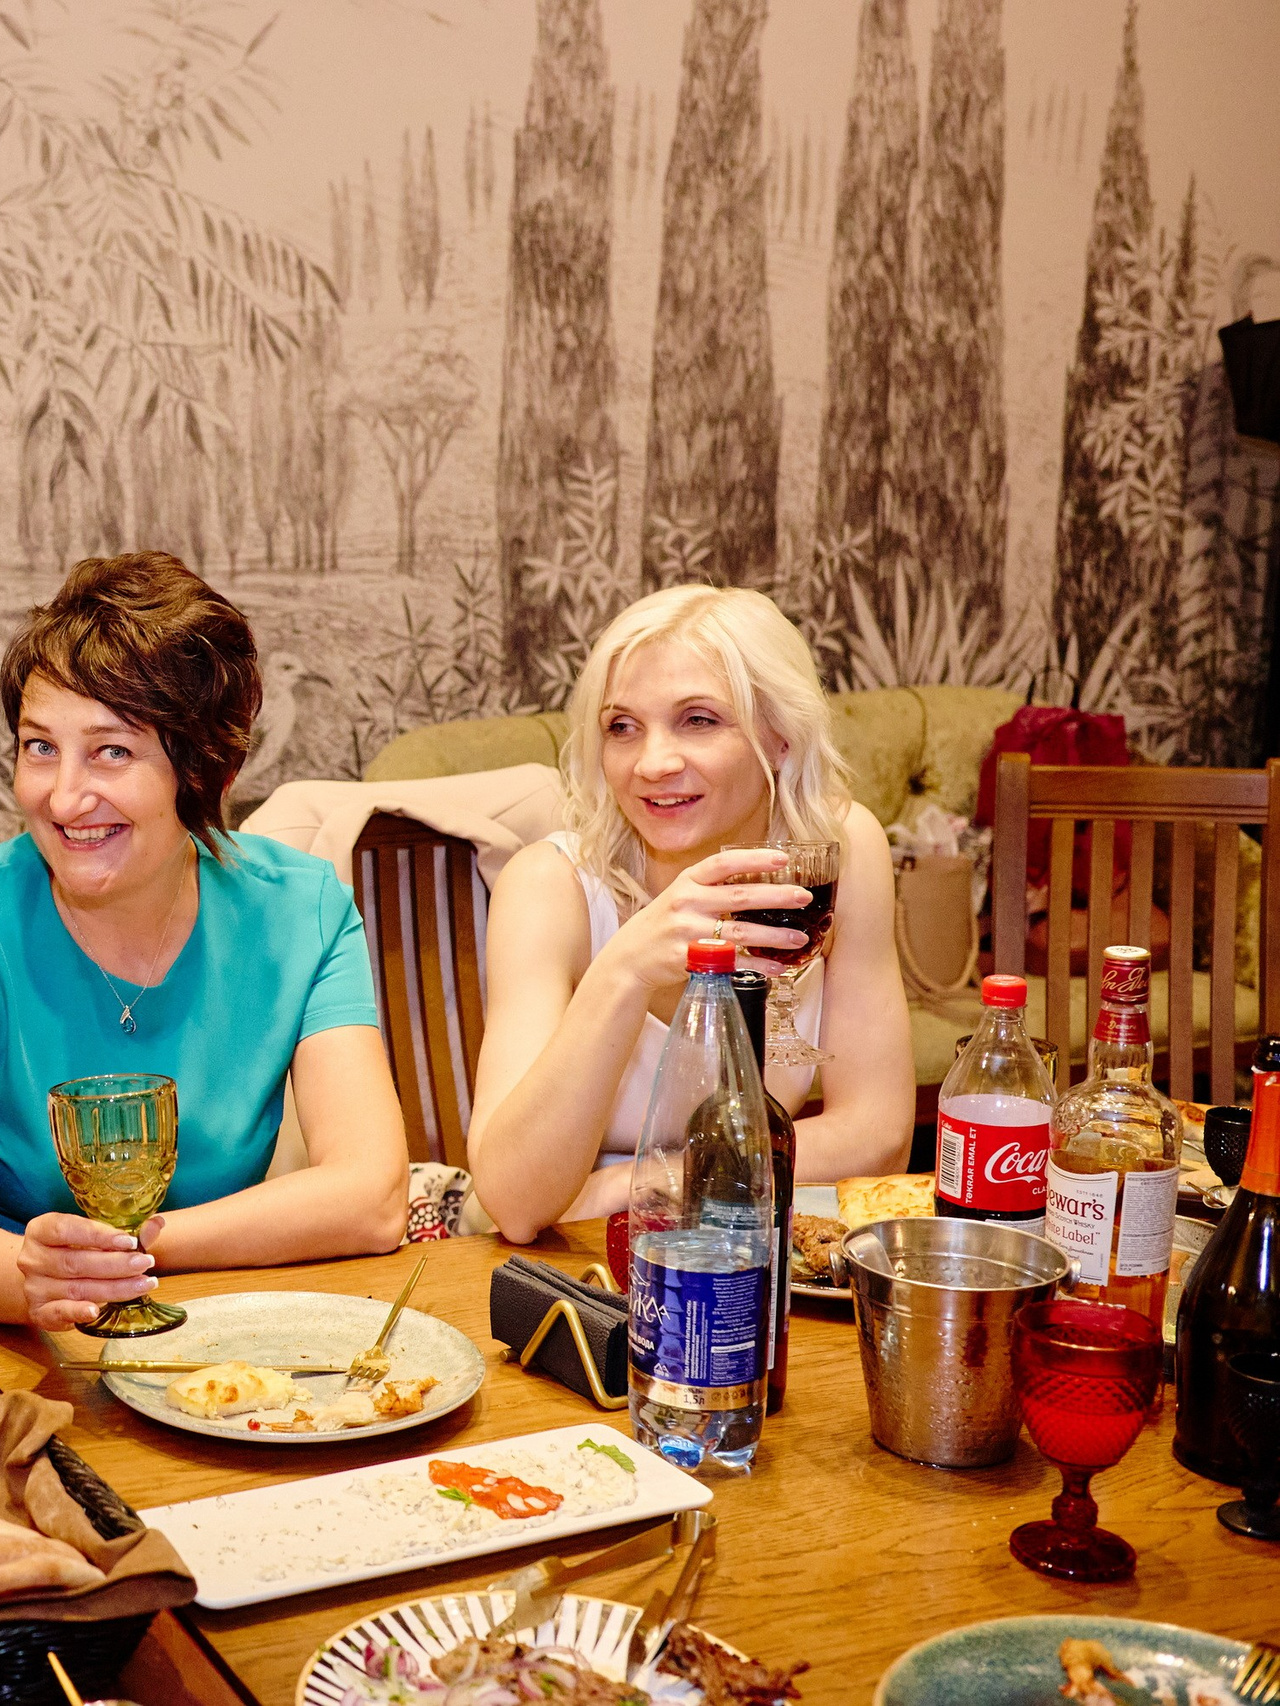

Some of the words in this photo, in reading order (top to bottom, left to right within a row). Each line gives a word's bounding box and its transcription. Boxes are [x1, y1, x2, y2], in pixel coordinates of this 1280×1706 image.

[969, 1127, 977, 1139] ET
[968, 1141, 976, 1166] EMAL
[1032, 1185, 1048, 1195] CLA
[1047, 1188, 1105, 1221] ewar's
[1062, 1226, 1094, 1246] Label
